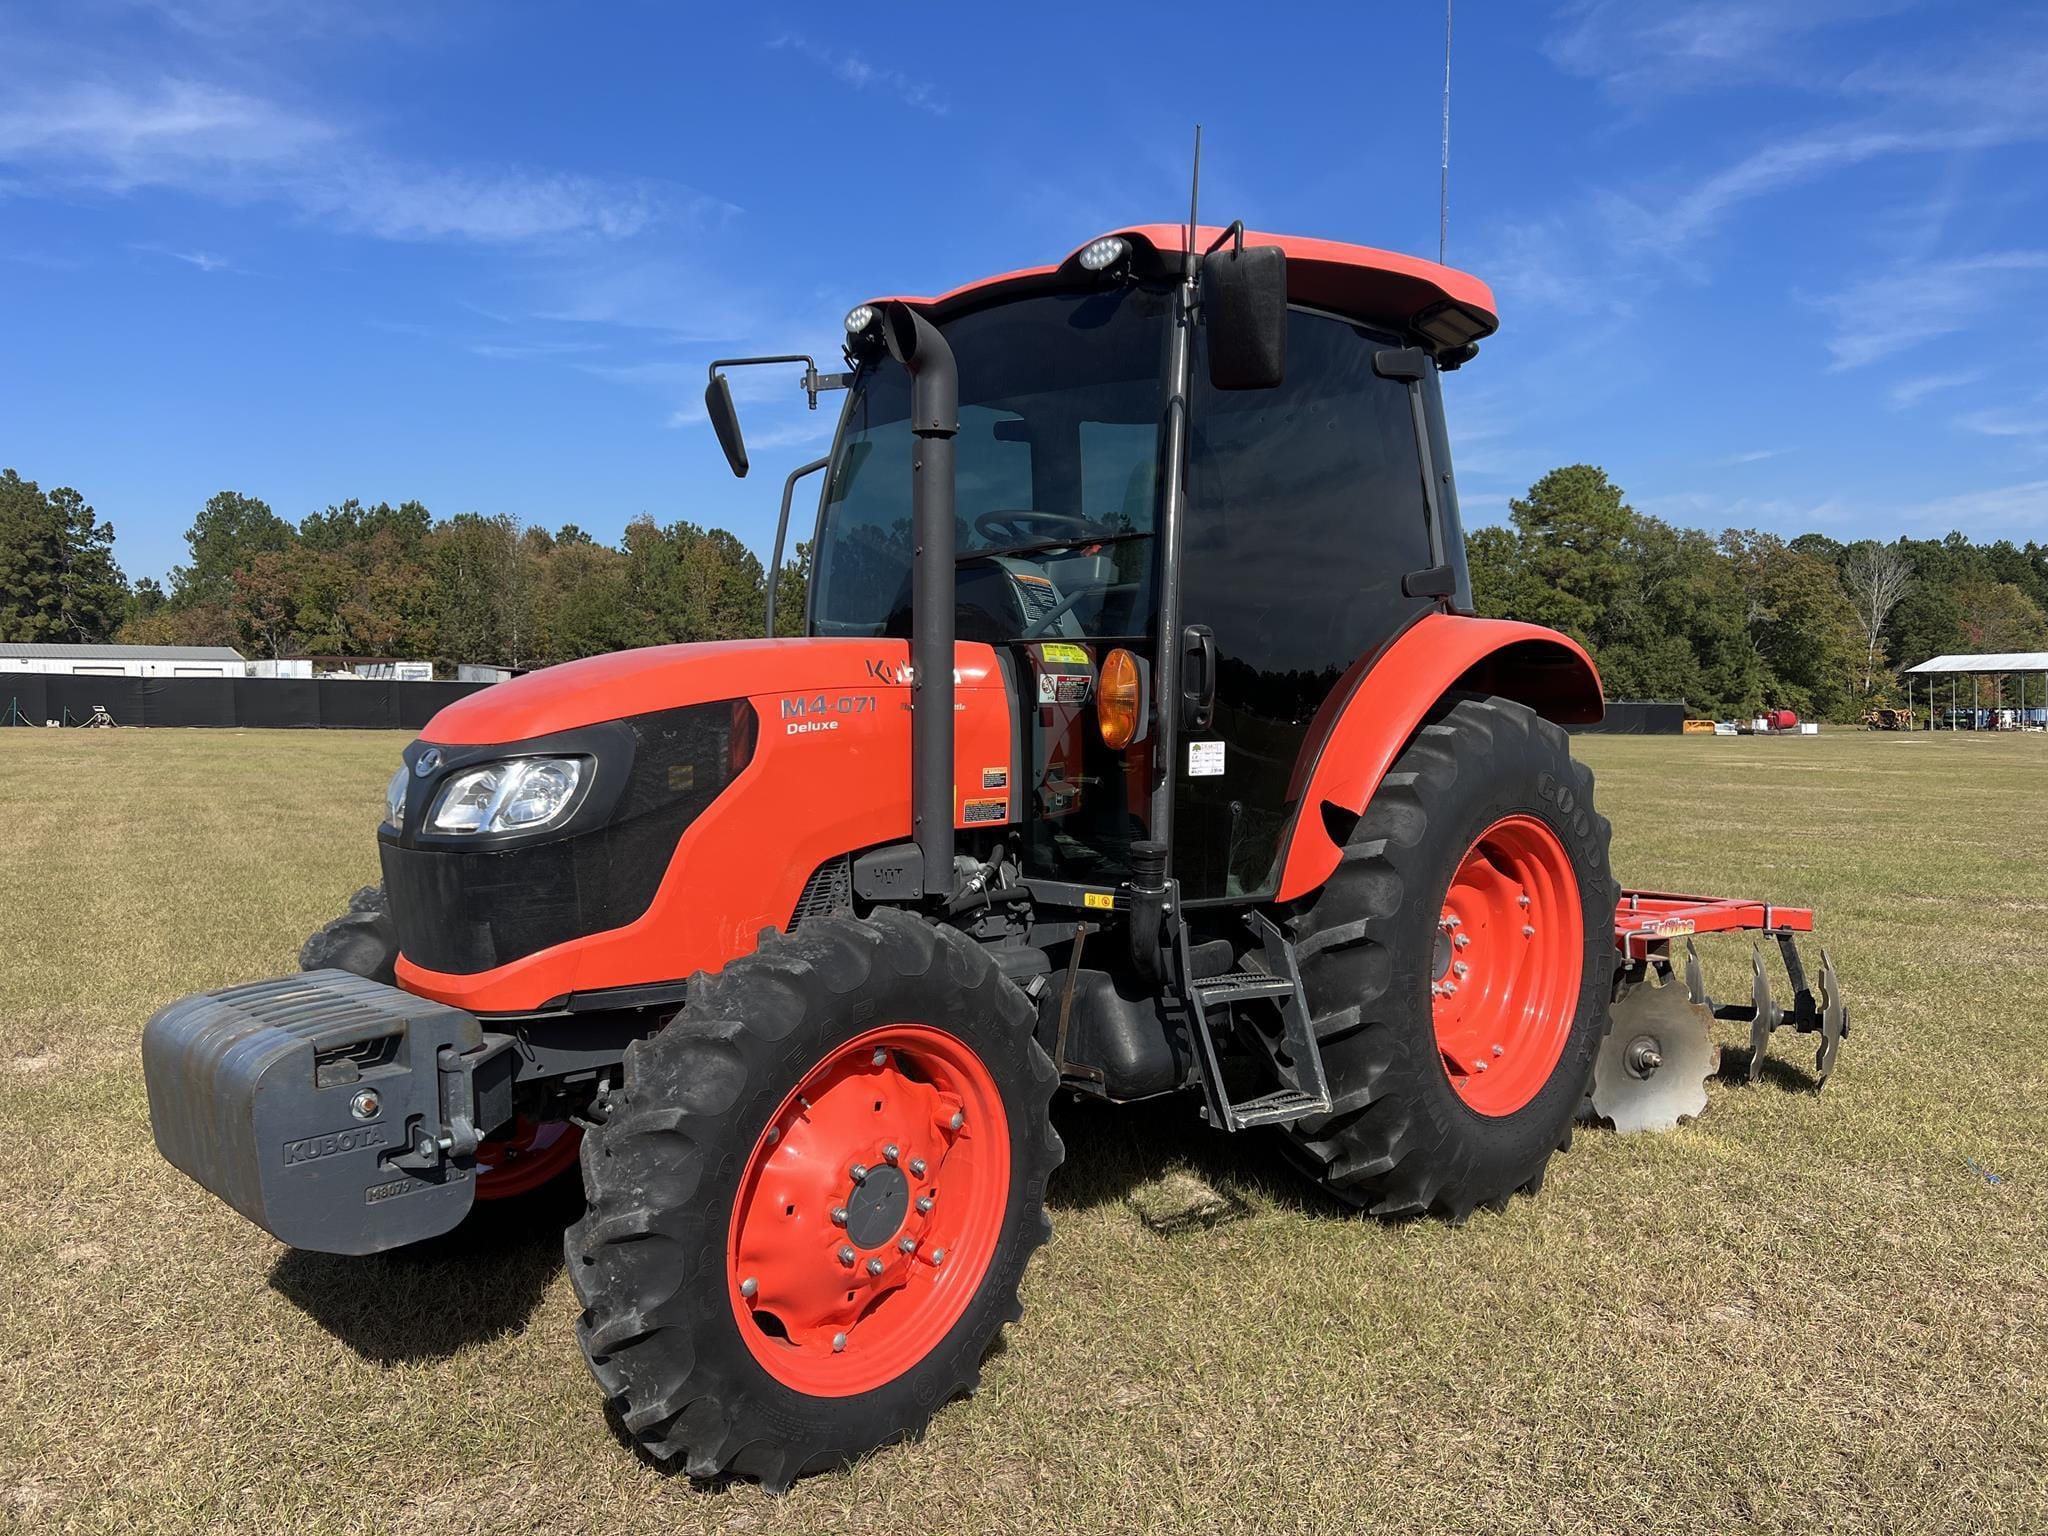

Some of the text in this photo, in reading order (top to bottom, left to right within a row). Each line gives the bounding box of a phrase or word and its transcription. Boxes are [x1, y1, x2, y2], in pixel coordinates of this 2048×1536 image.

[781, 695, 877, 719] M4-071
[786, 719, 839, 735] Deluxe
[285, 1125, 387, 1165] KUBOTA
